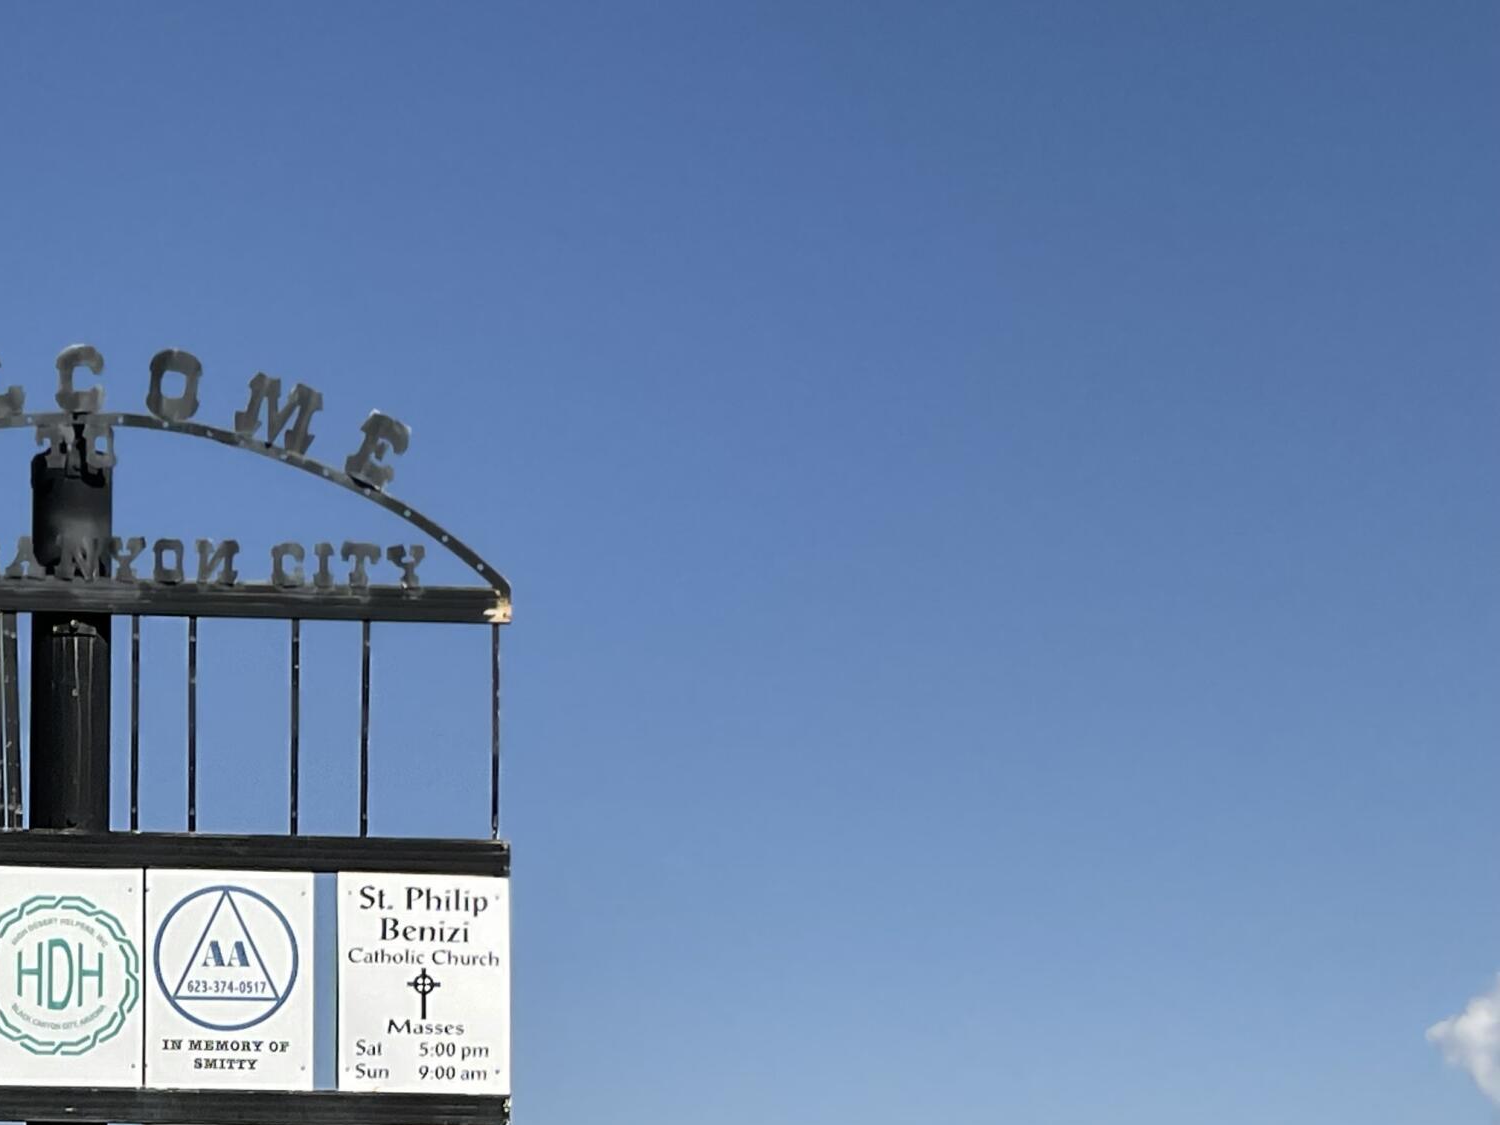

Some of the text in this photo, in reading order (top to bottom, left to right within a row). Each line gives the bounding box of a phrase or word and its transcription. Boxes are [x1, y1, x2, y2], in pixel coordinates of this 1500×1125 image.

[36, 424, 116, 474] TO
[270, 542, 427, 589] CITY
[359, 885, 488, 917] St. Philip
[380, 917, 469, 942] Benizi
[202, 940, 250, 967] AA
[348, 948, 499, 966] Catholic Church
[17, 938, 103, 1010] HDH
[187, 980, 266, 994] 623-374-0517
[387, 1019, 465, 1035] Masses
[162, 1039, 289, 1052] IN MEMORY OF
[356, 1039, 489, 1060] Sat 5:00 pm
[194, 1058, 258, 1070] SMITTY
[355, 1063, 487, 1080] Sun 9:00 am
